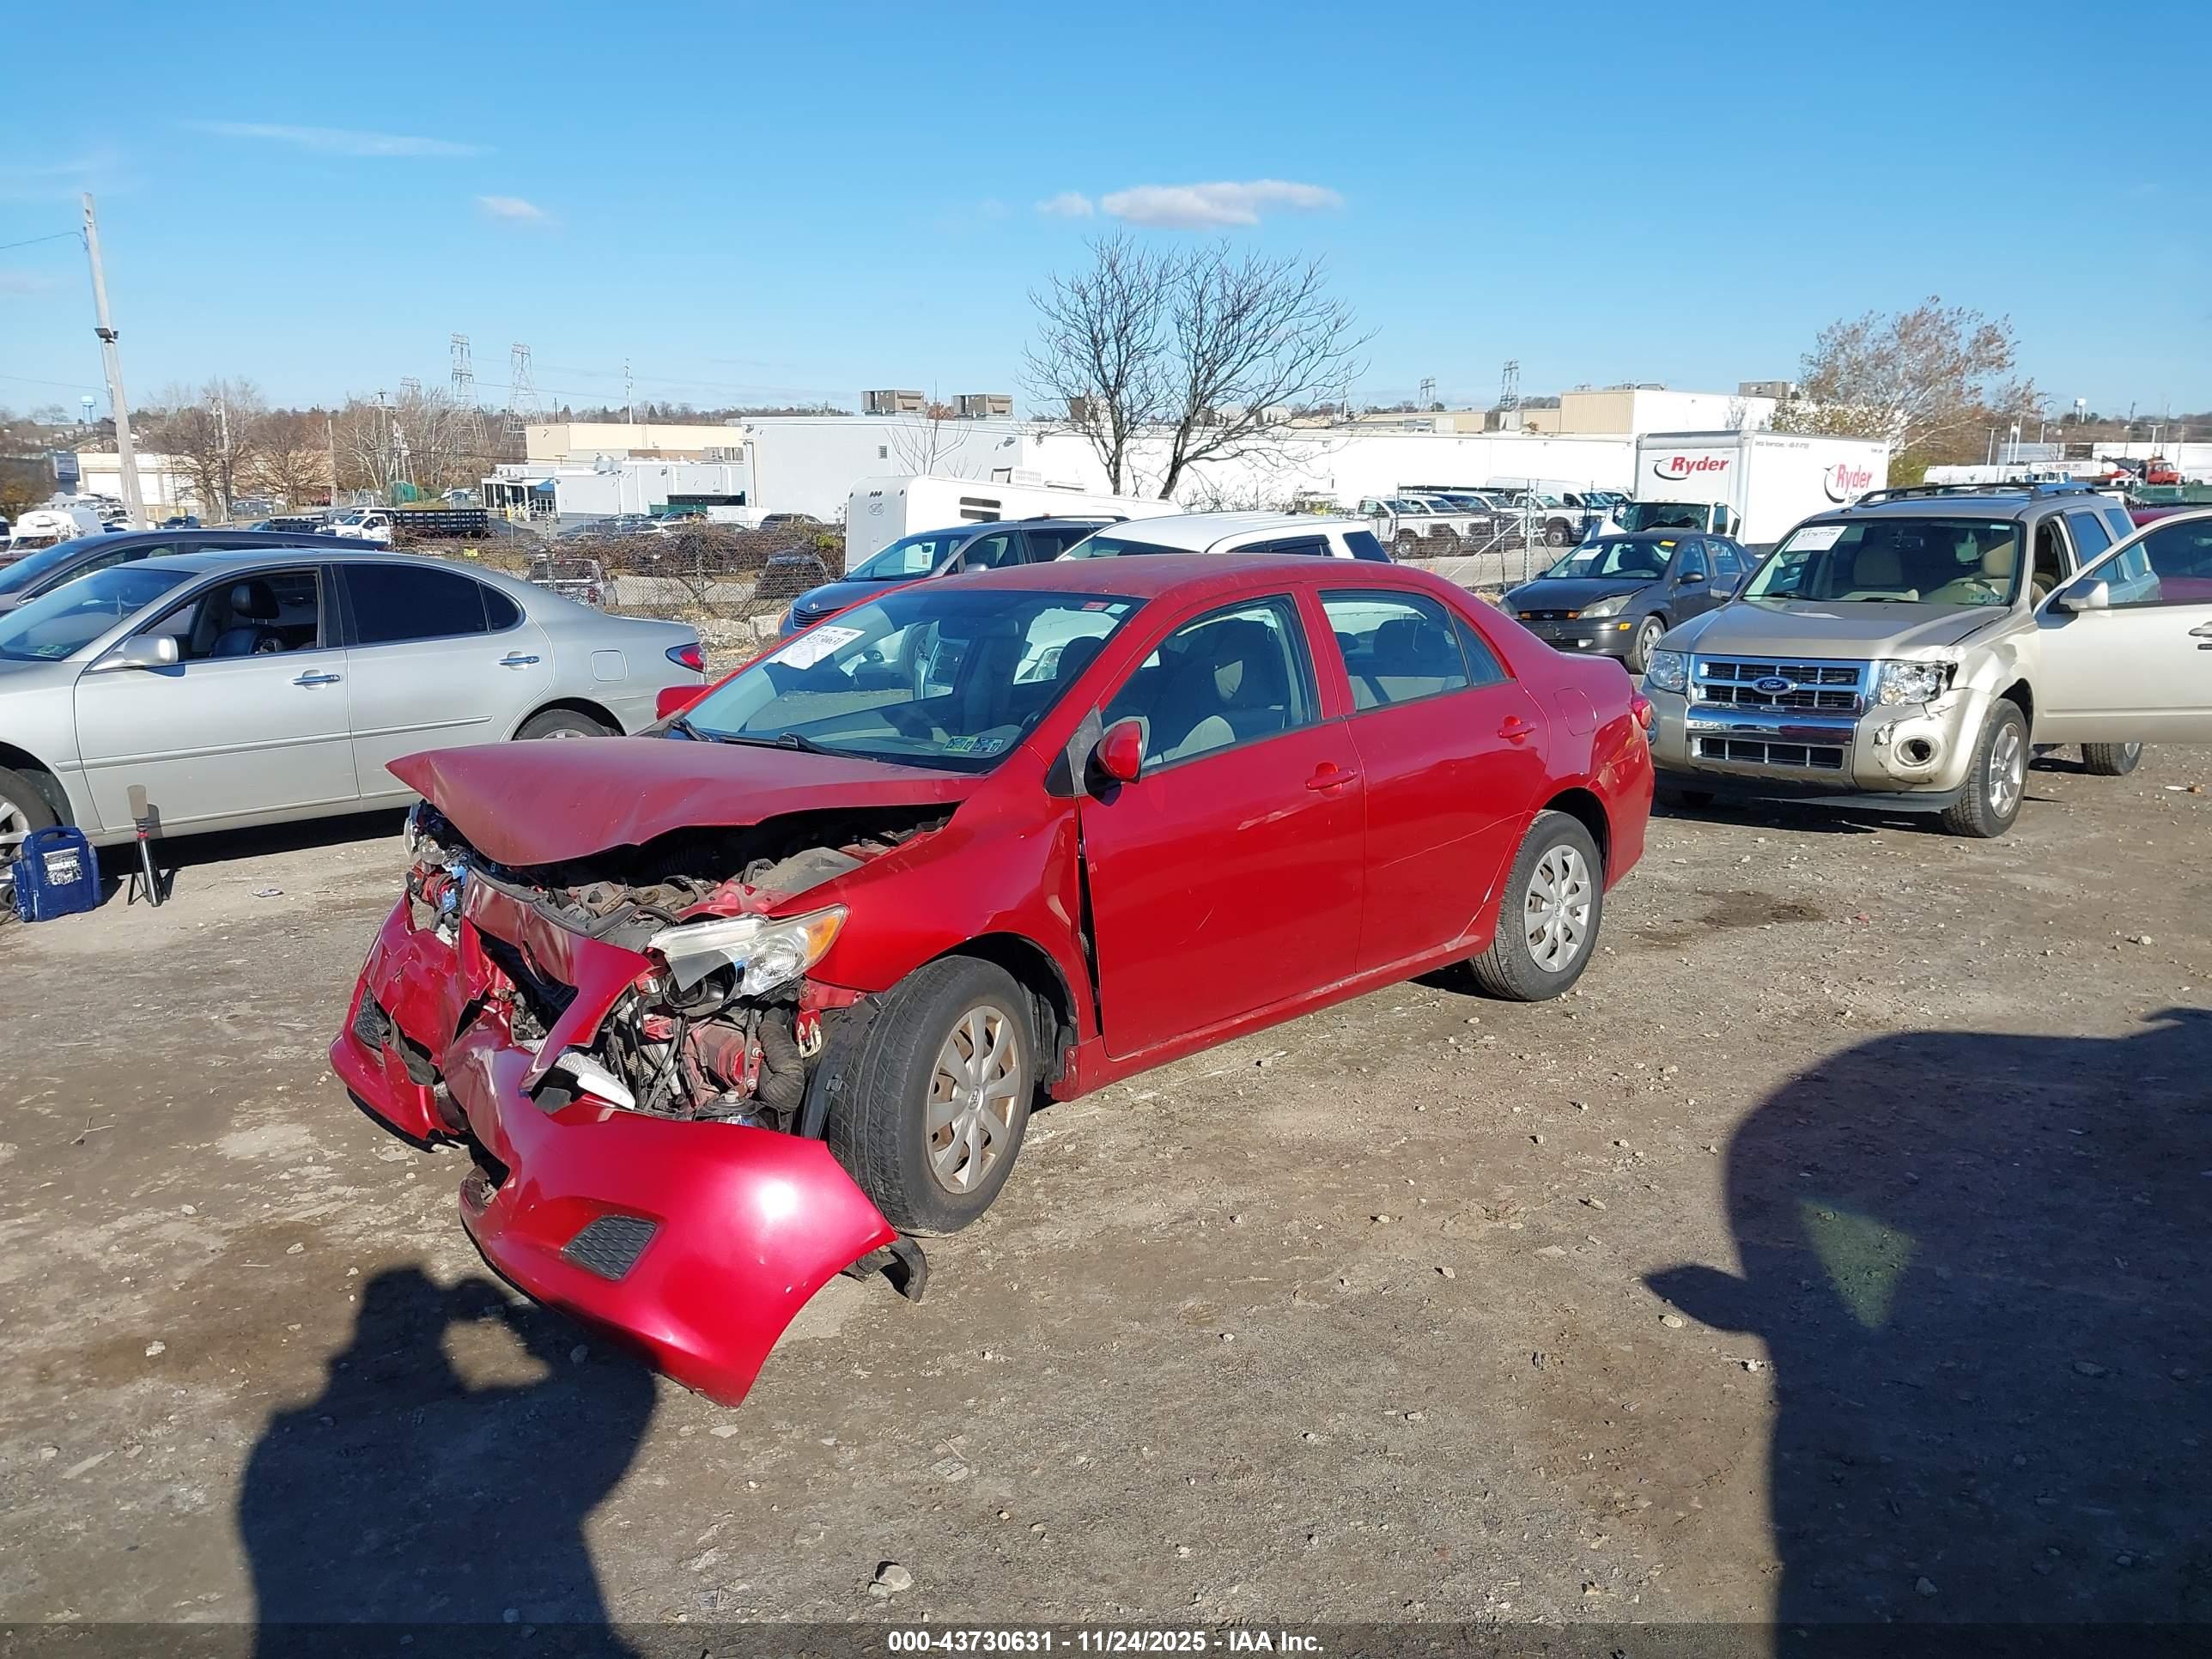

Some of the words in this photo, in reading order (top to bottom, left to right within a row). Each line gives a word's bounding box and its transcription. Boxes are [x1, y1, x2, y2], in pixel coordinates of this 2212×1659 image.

[1670, 456, 1729, 475] Ryder
[1836, 464, 1874, 494] Ryder
[1761, 679, 1784, 690] Ford
